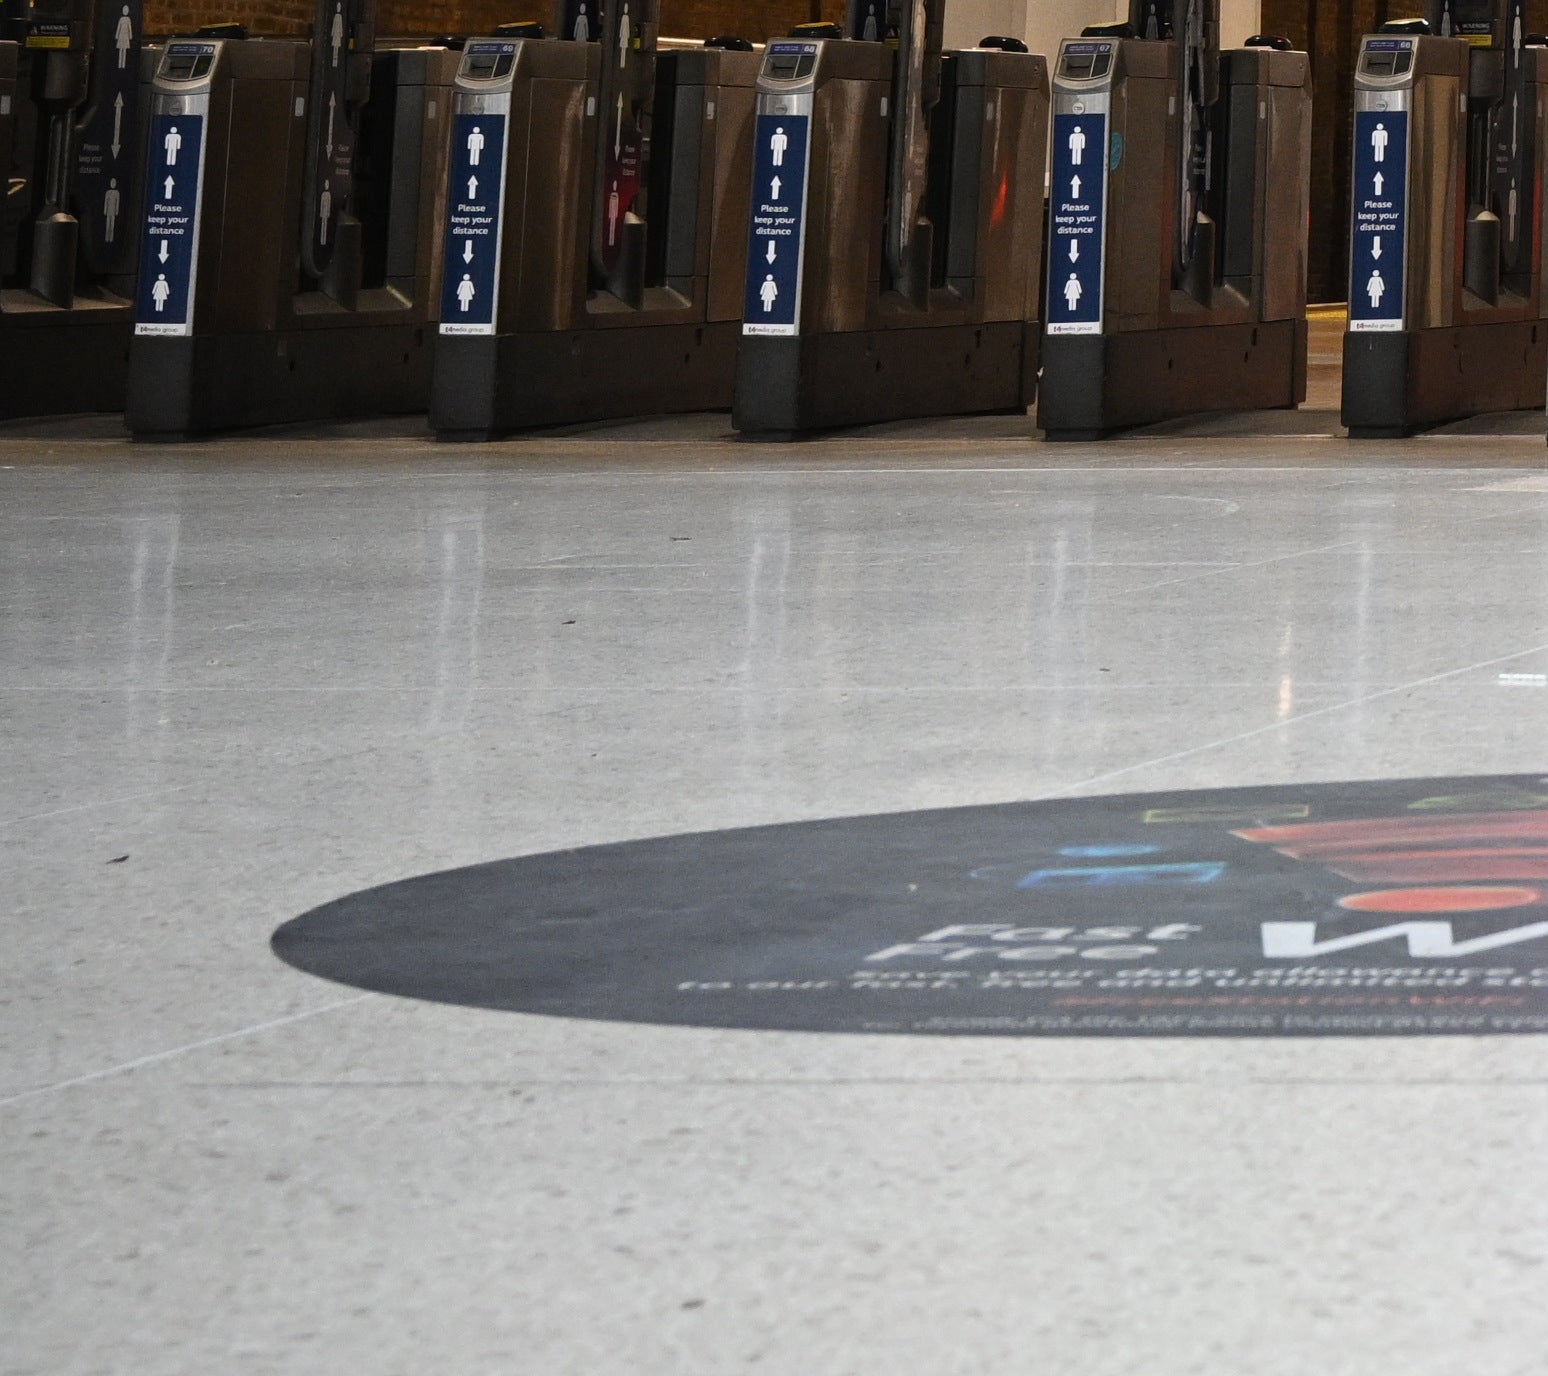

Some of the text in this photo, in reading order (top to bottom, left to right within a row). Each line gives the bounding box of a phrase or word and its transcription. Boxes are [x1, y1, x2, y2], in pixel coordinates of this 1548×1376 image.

[153, 203, 182, 213] Please
[147, 214, 189, 225] keep your
[148, 226, 185, 235] distance
